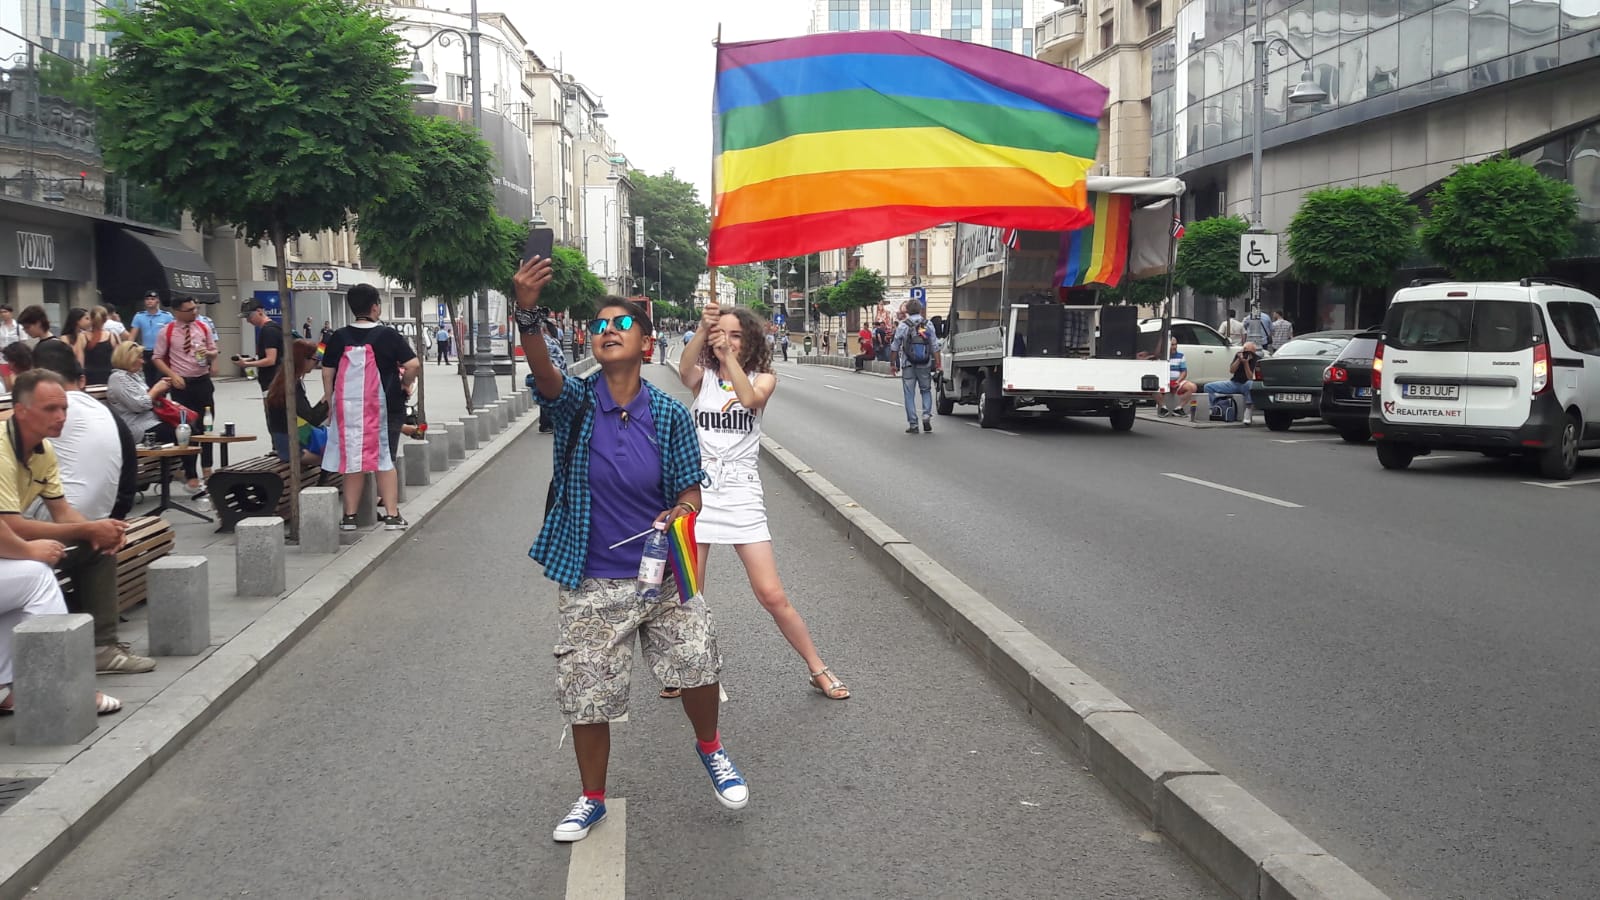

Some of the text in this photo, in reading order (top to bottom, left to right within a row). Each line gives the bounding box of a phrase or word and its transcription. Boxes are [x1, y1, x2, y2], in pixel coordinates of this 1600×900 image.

[16, 230, 55, 271] YOKKO
[1410, 385, 1456, 397] B 83 UUF
[694, 408, 756, 434] Equality
[1396, 408, 1462, 417] REALITATEA.NET
